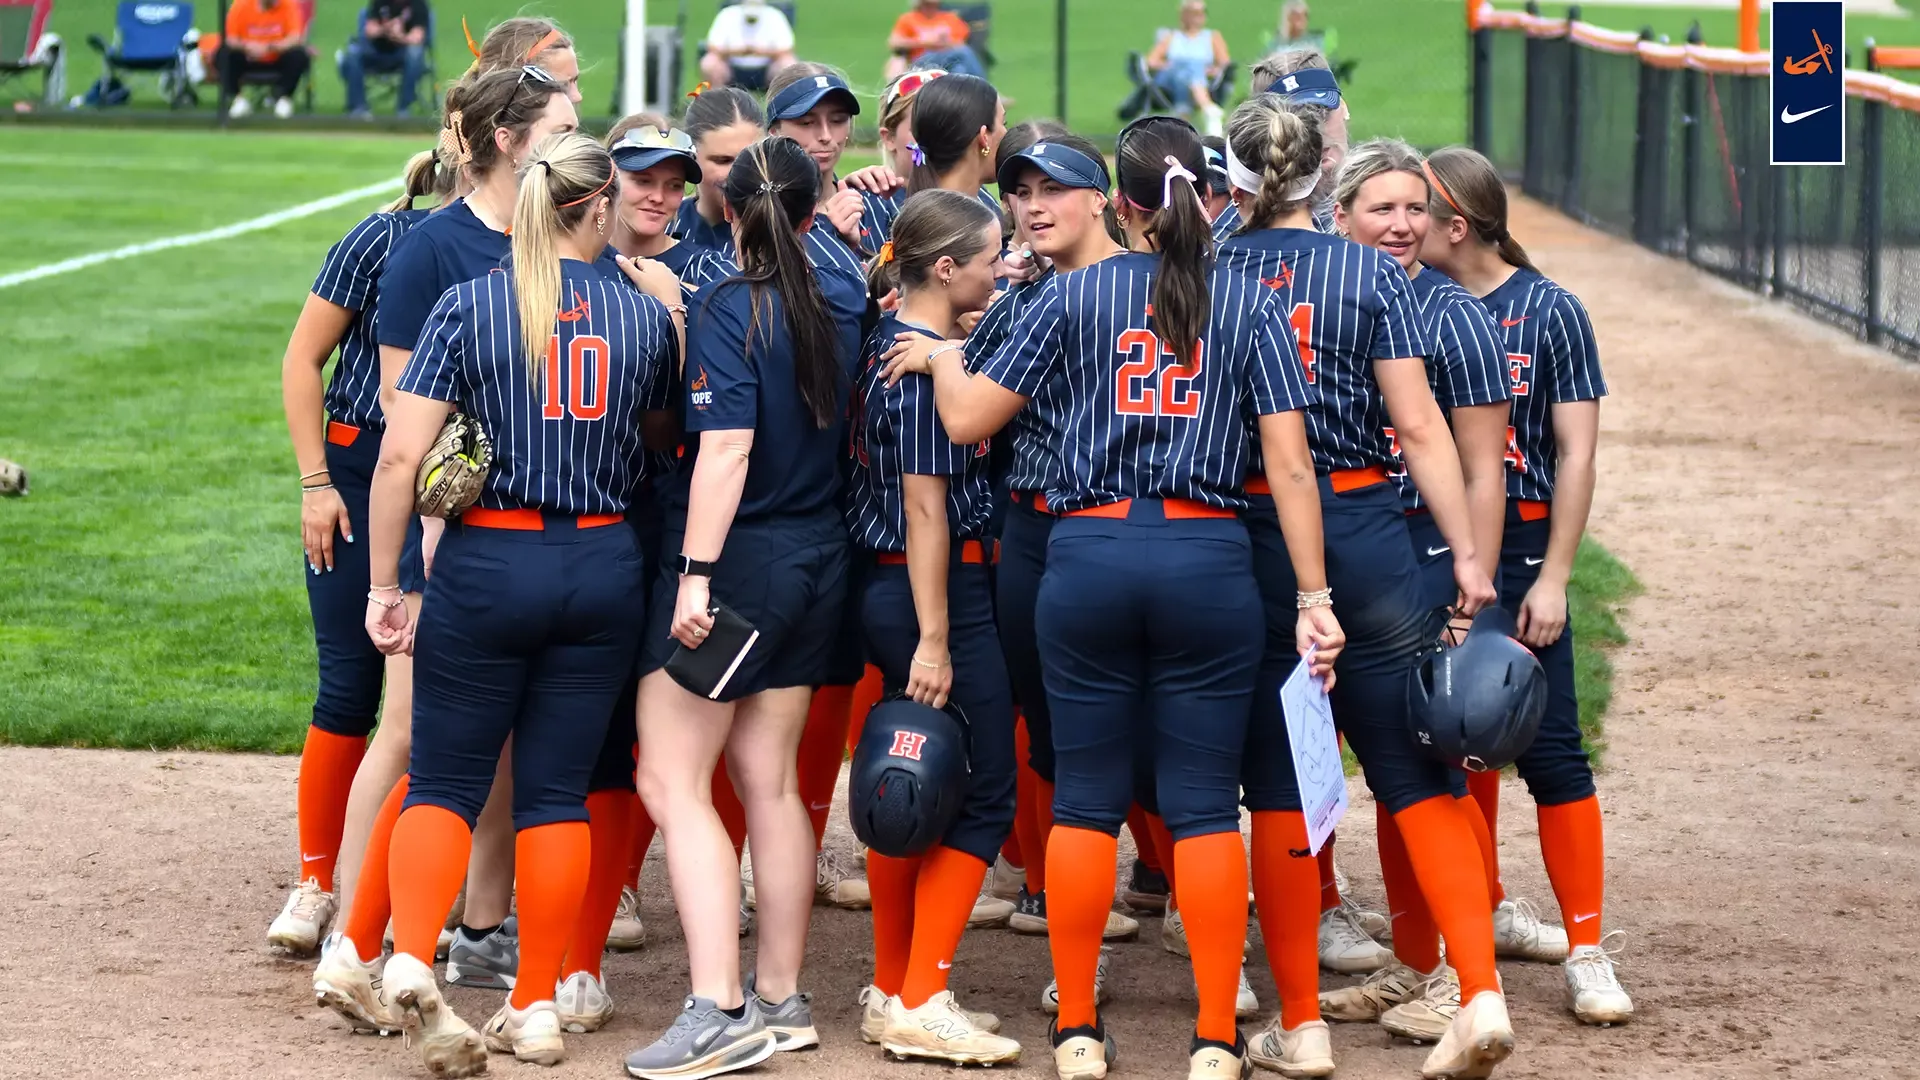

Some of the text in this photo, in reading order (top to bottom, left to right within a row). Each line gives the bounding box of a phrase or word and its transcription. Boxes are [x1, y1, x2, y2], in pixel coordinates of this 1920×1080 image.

[1282, 75, 1300, 92] H
[541, 334, 611, 421] 10
[1115, 328, 1204, 418] 22
[428, 477, 448, 506] A2000
[888, 730, 928, 761] H
[1417, 731, 1433, 745] 24
